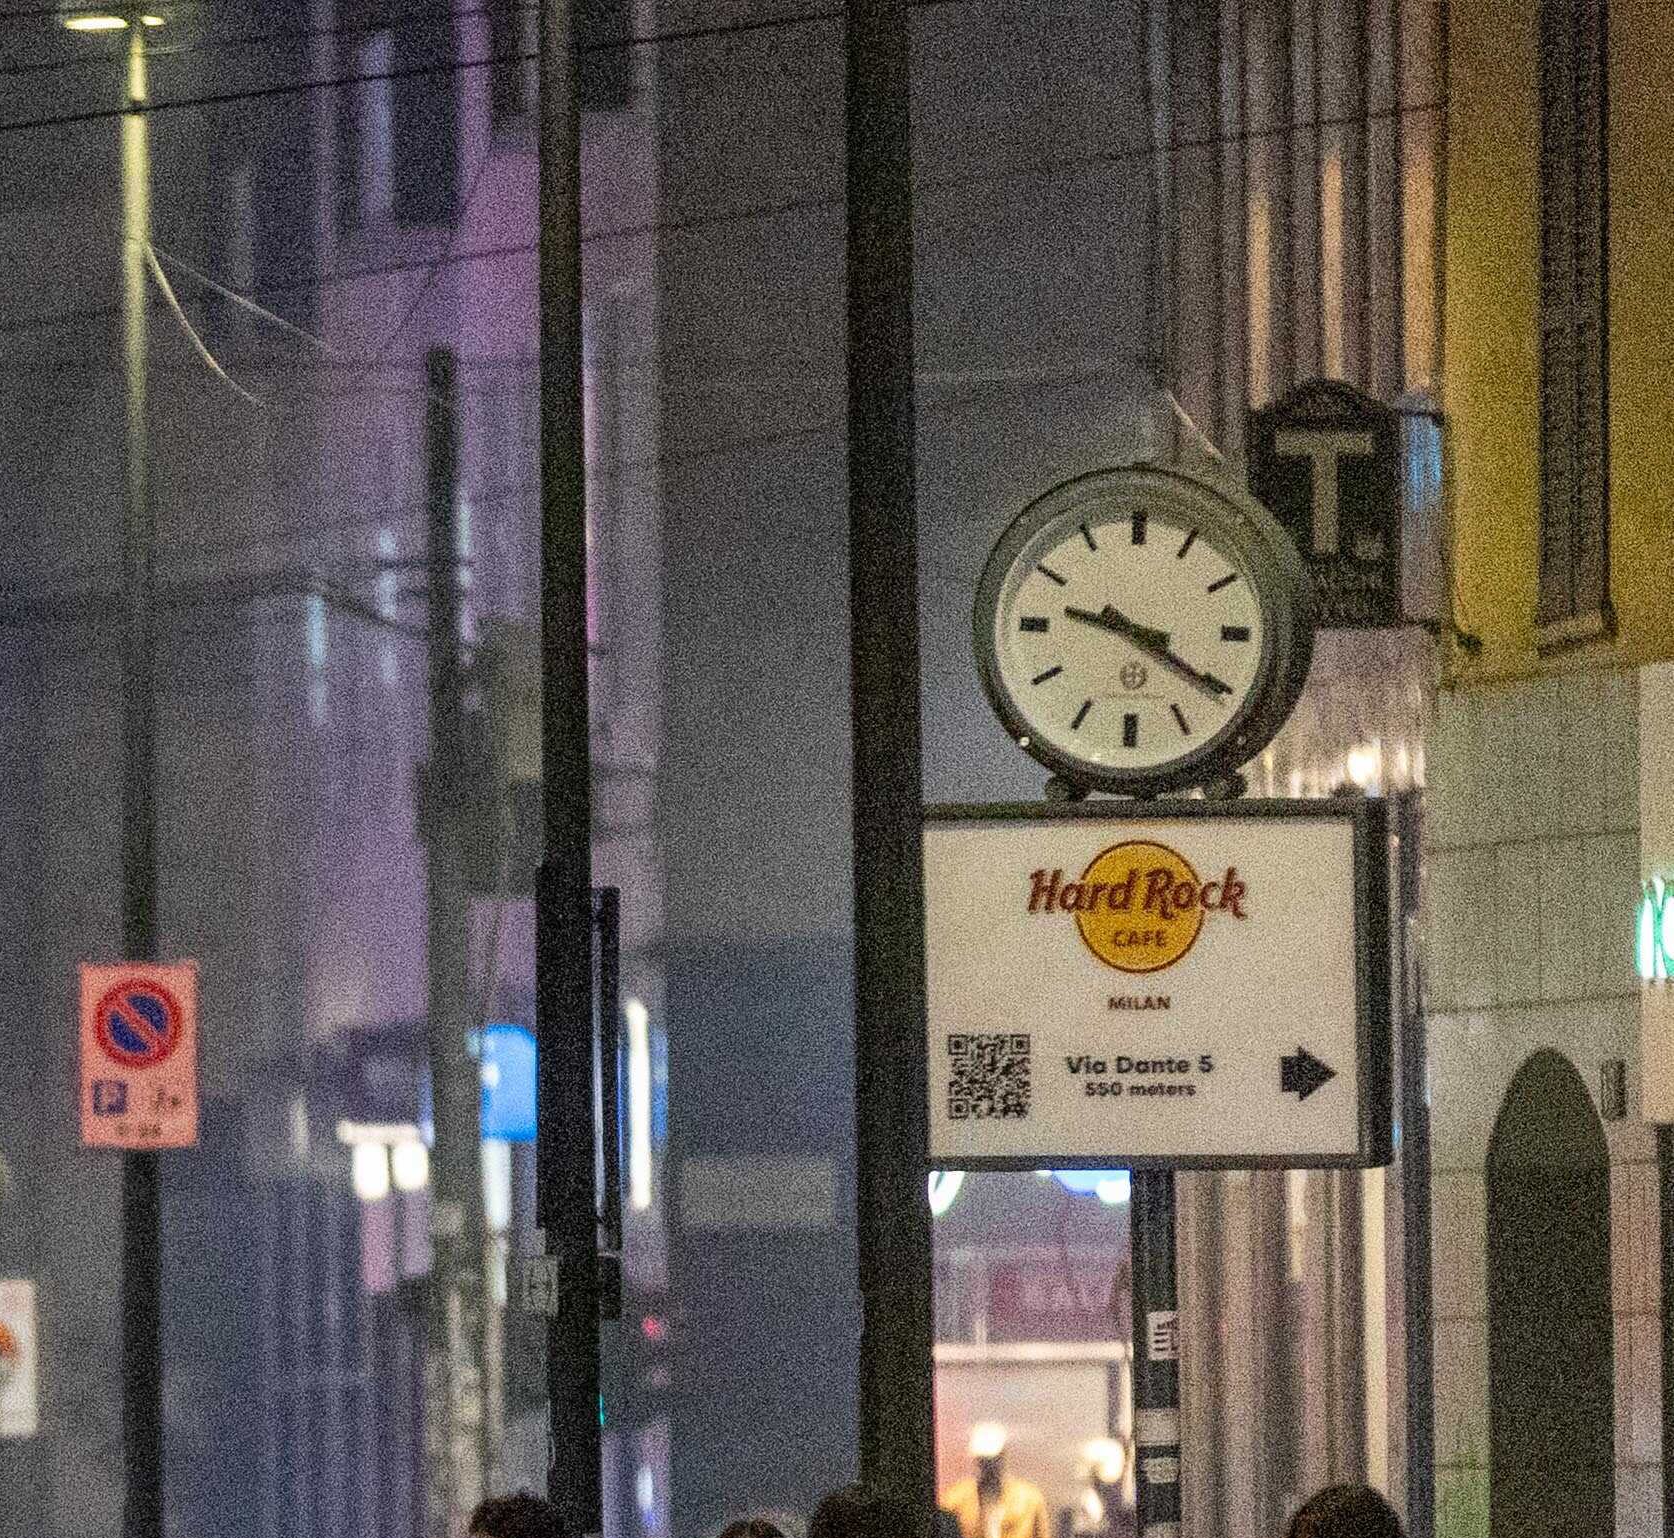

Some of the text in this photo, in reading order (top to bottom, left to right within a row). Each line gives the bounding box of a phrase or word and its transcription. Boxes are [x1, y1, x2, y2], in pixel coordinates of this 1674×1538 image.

[1028, 866, 1248, 920] Hard Rock
[1112, 929, 1168, 947] CAFE
[1108, 996, 1171, 1011] MILAN
[1065, 1055, 1214, 1074] Via Dante 5
[1085, 1082, 1197, 1097] 550 meters
